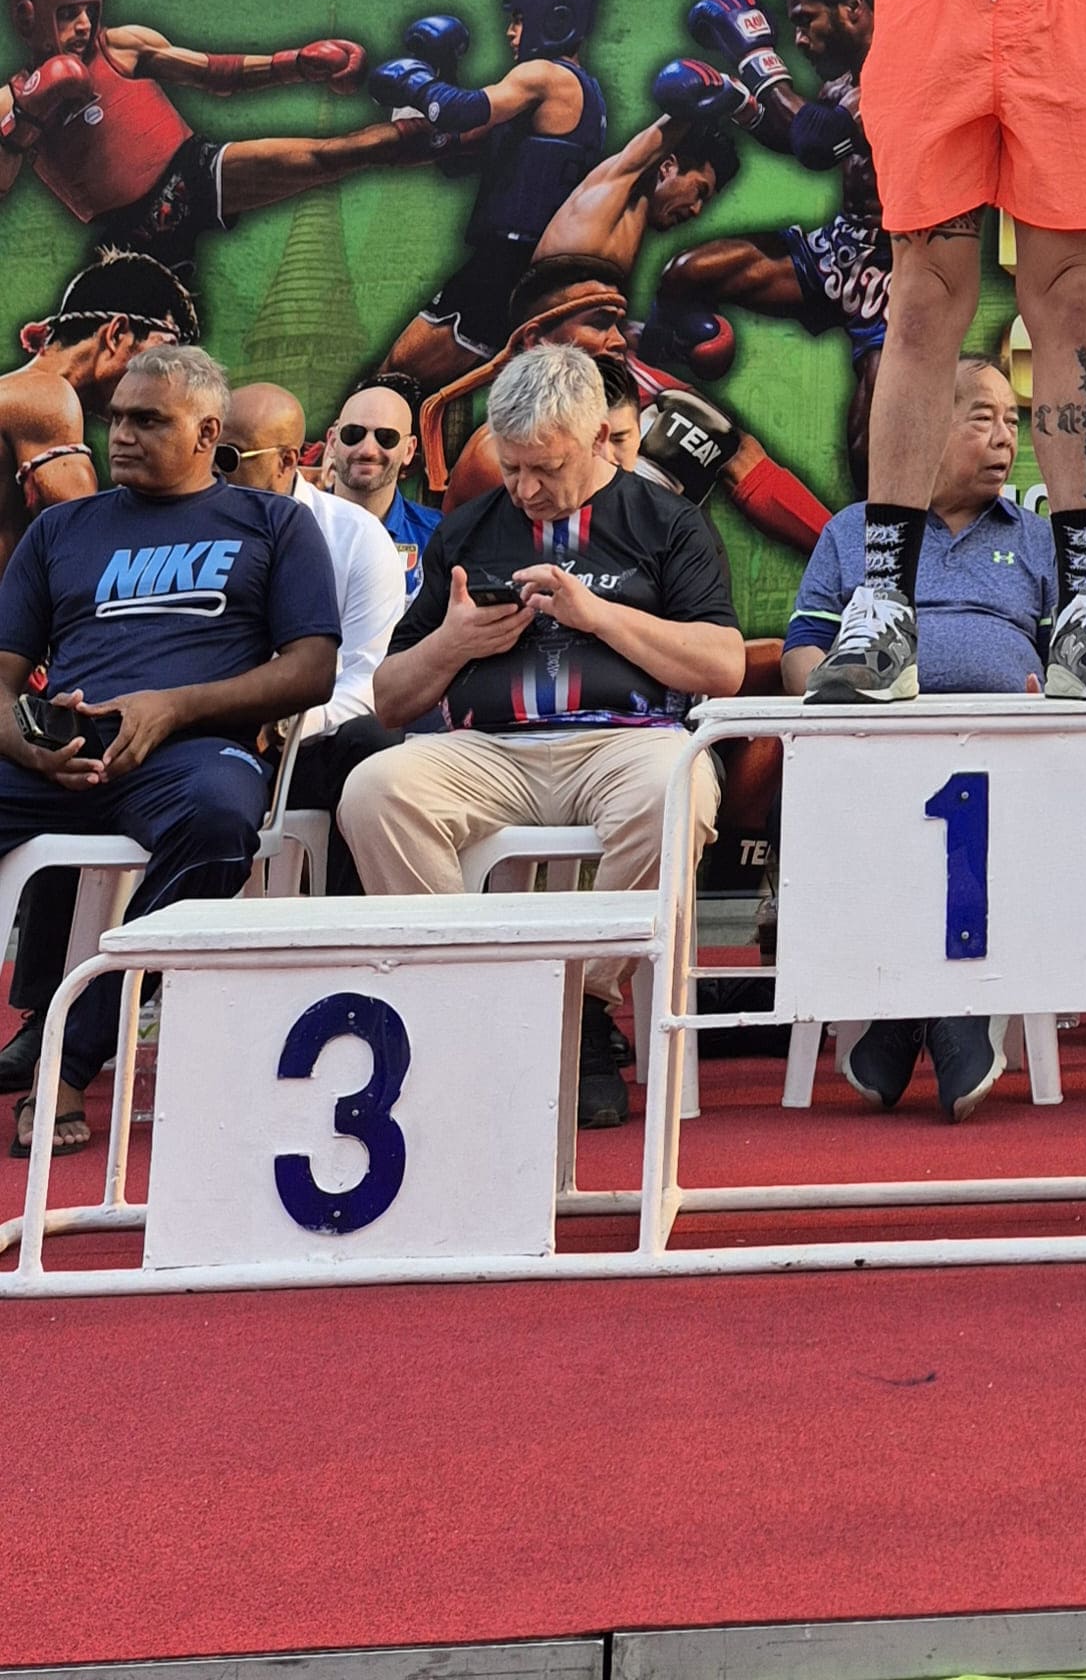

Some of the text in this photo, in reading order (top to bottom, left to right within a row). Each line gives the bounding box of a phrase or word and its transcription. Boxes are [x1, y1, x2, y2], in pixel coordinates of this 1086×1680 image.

[95, 540, 244, 604] NIKE
[740, 839, 772, 866] TE
[925, 772, 989, 960] 1
[274, 992, 412, 1234] 3
